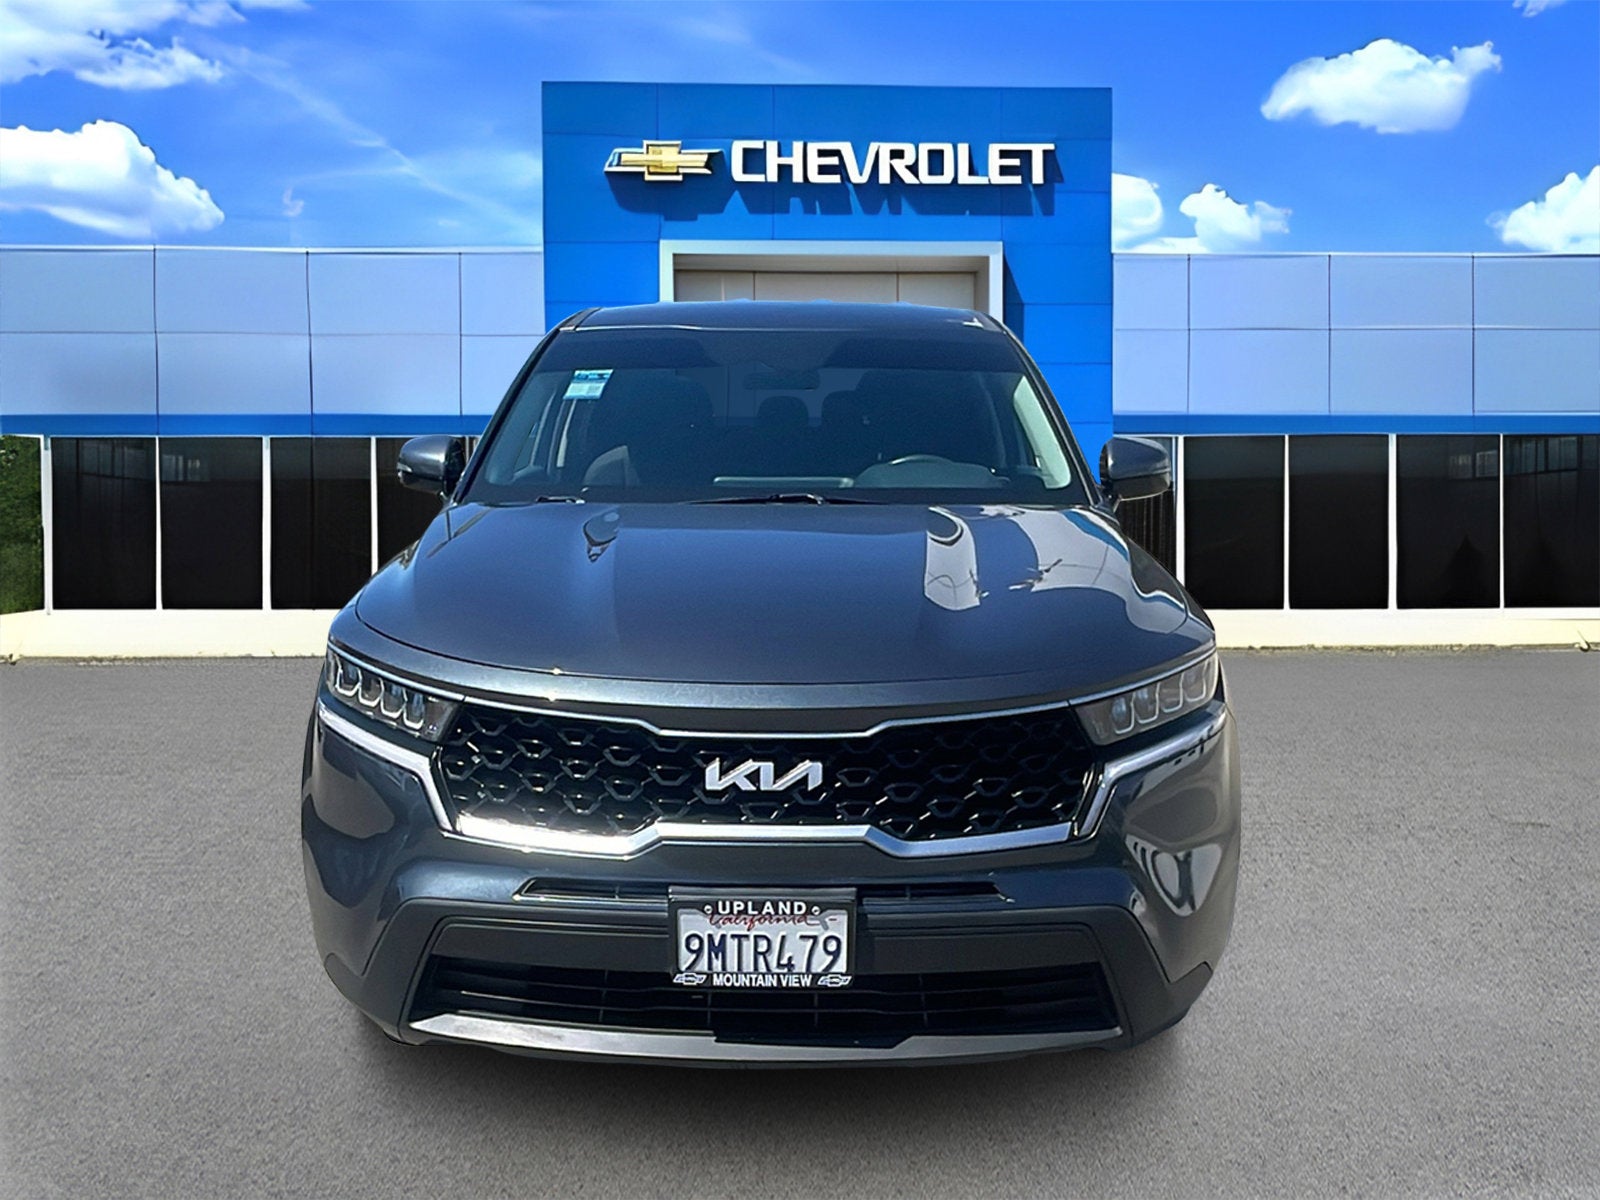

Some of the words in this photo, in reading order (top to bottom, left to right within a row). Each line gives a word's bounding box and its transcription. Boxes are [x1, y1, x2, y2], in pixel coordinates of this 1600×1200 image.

[731, 140, 1055, 186] CHEVROLET
[705, 757, 823, 791] KIA
[717, 900, 807, 915] UPLAND
[684, 933, 843, 973] 9MTR479
[713, 974, 777, 987] MOUNTAIN
[779, 974, 813, 987] VIEW
